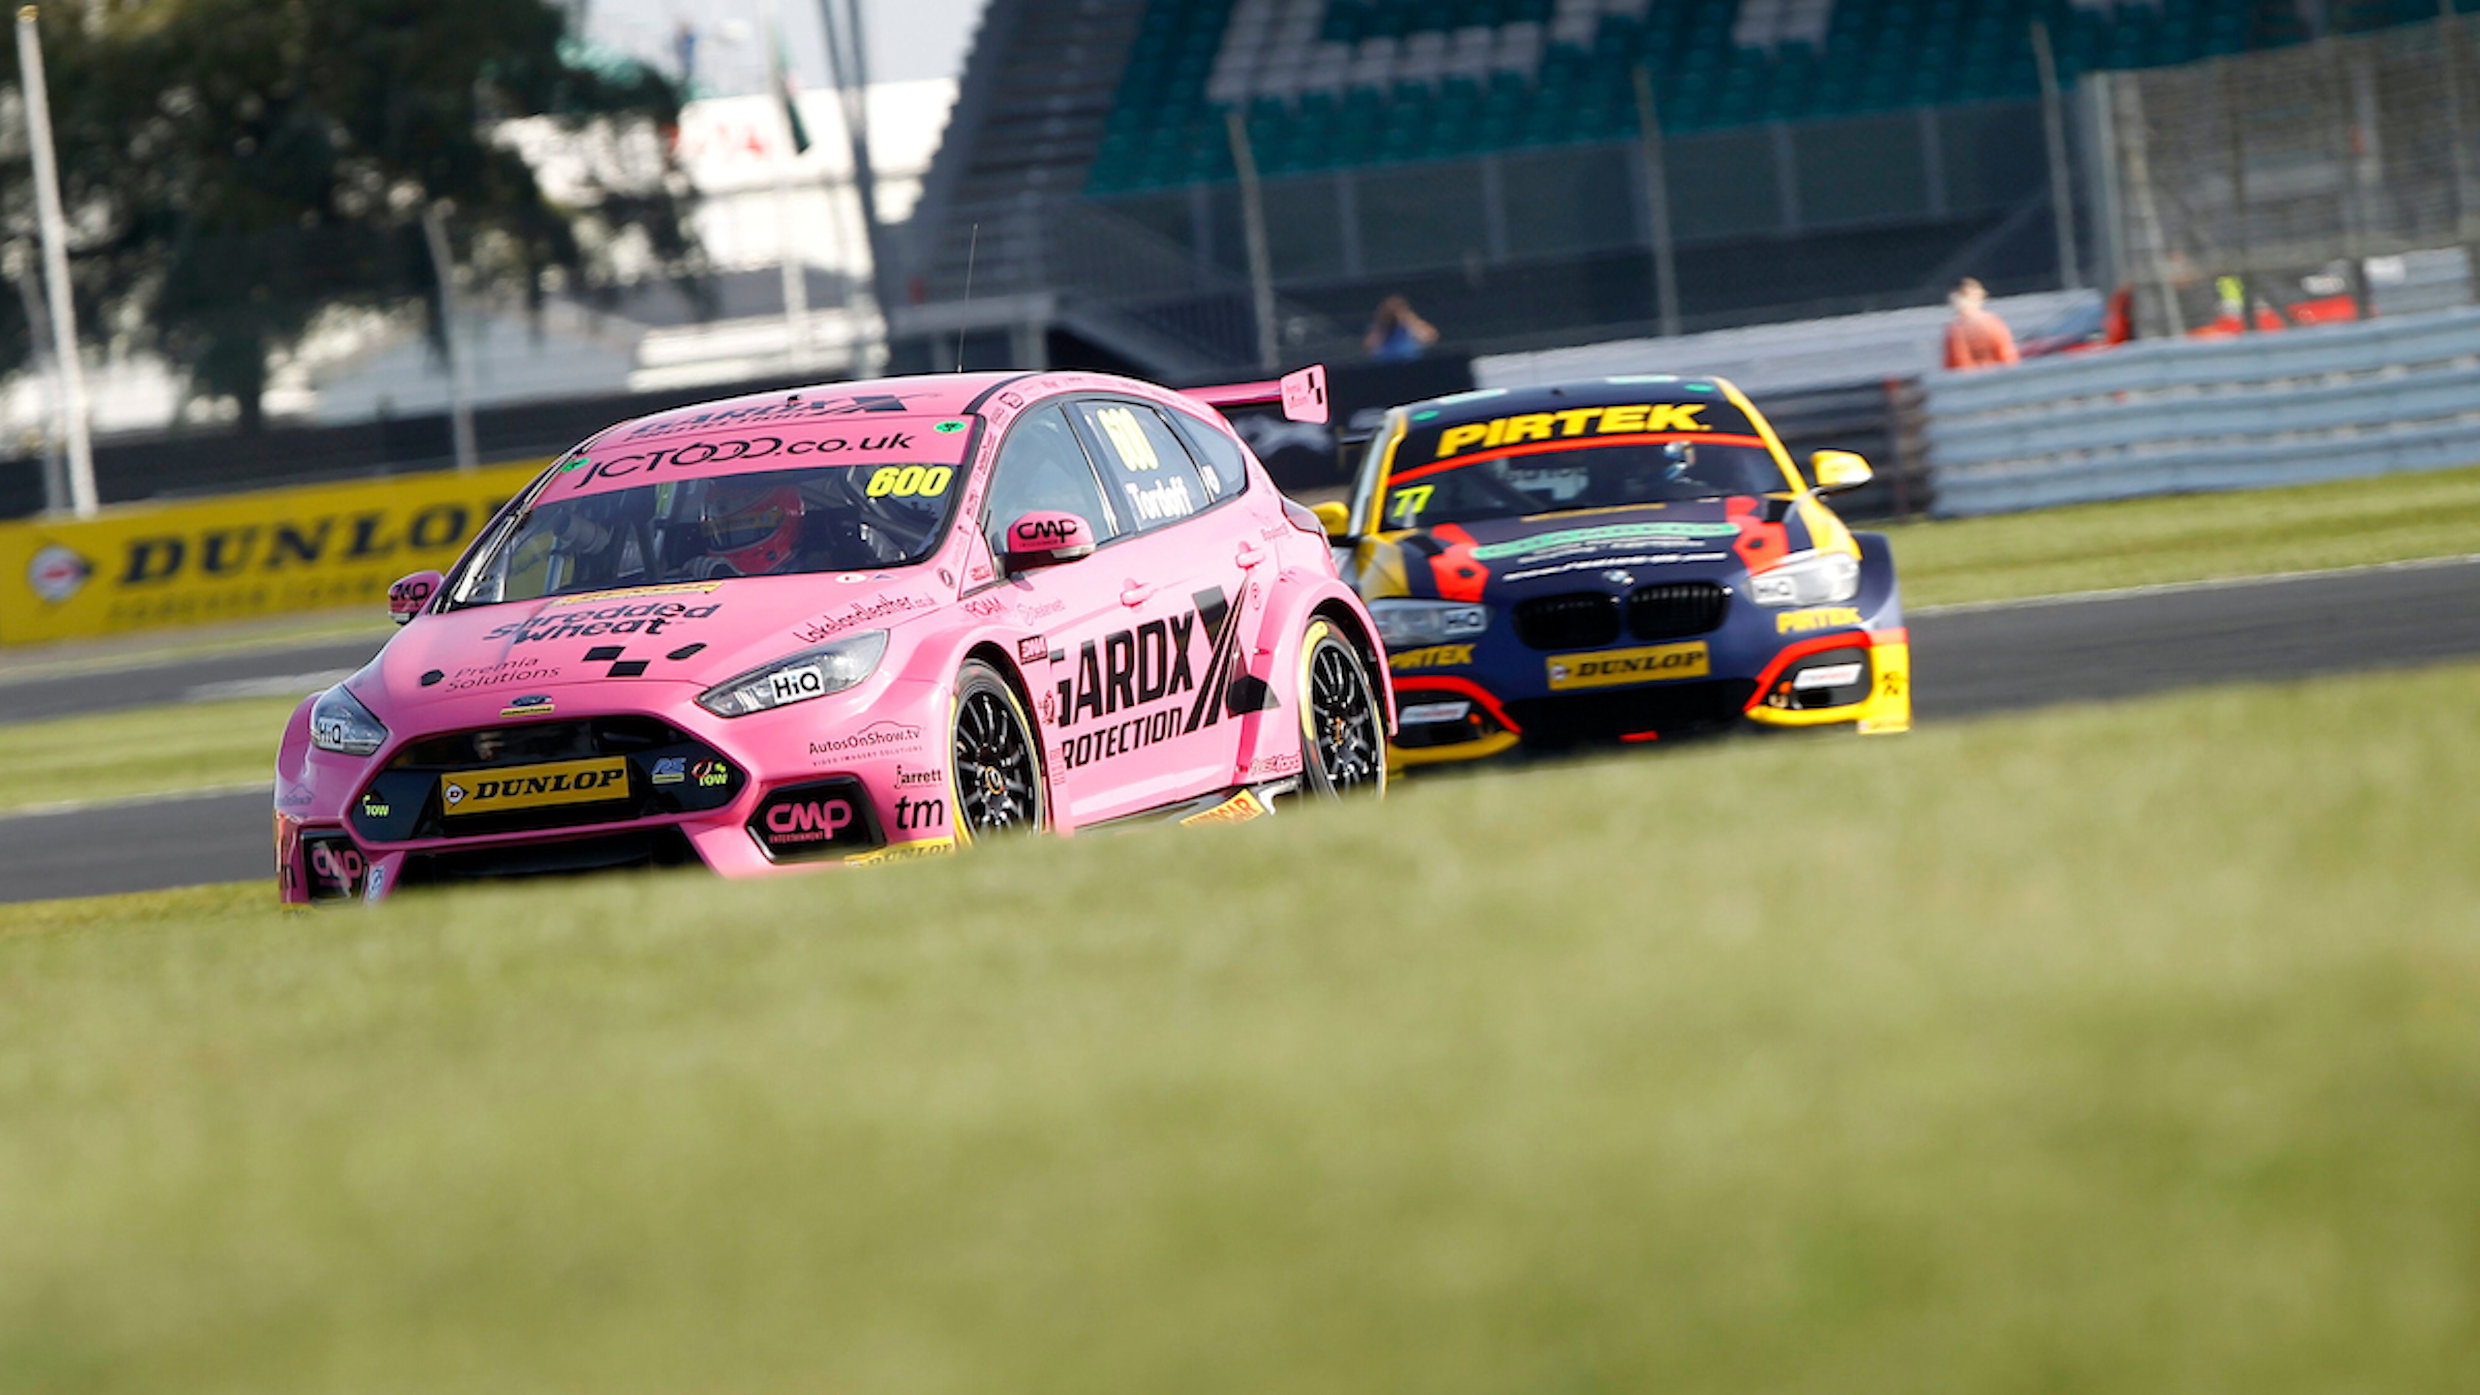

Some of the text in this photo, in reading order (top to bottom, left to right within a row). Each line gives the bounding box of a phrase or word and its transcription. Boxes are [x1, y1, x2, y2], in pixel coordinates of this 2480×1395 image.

[1436, 404, 1707, 458] PIRTEK
[865, 466, 953, 498] 600
[1394, 485, 1435, 518] 77
[118, 496, 511, 584] DUNLO
[1575, 650, 1708, 677] DUNLOP
[772, 669, 821, 700] HiQ
[1061, 706, 1183, 770] ROTECTION
[473, 768, 625, 800] DUNLOP
[894, 795, 944, 831] tm
